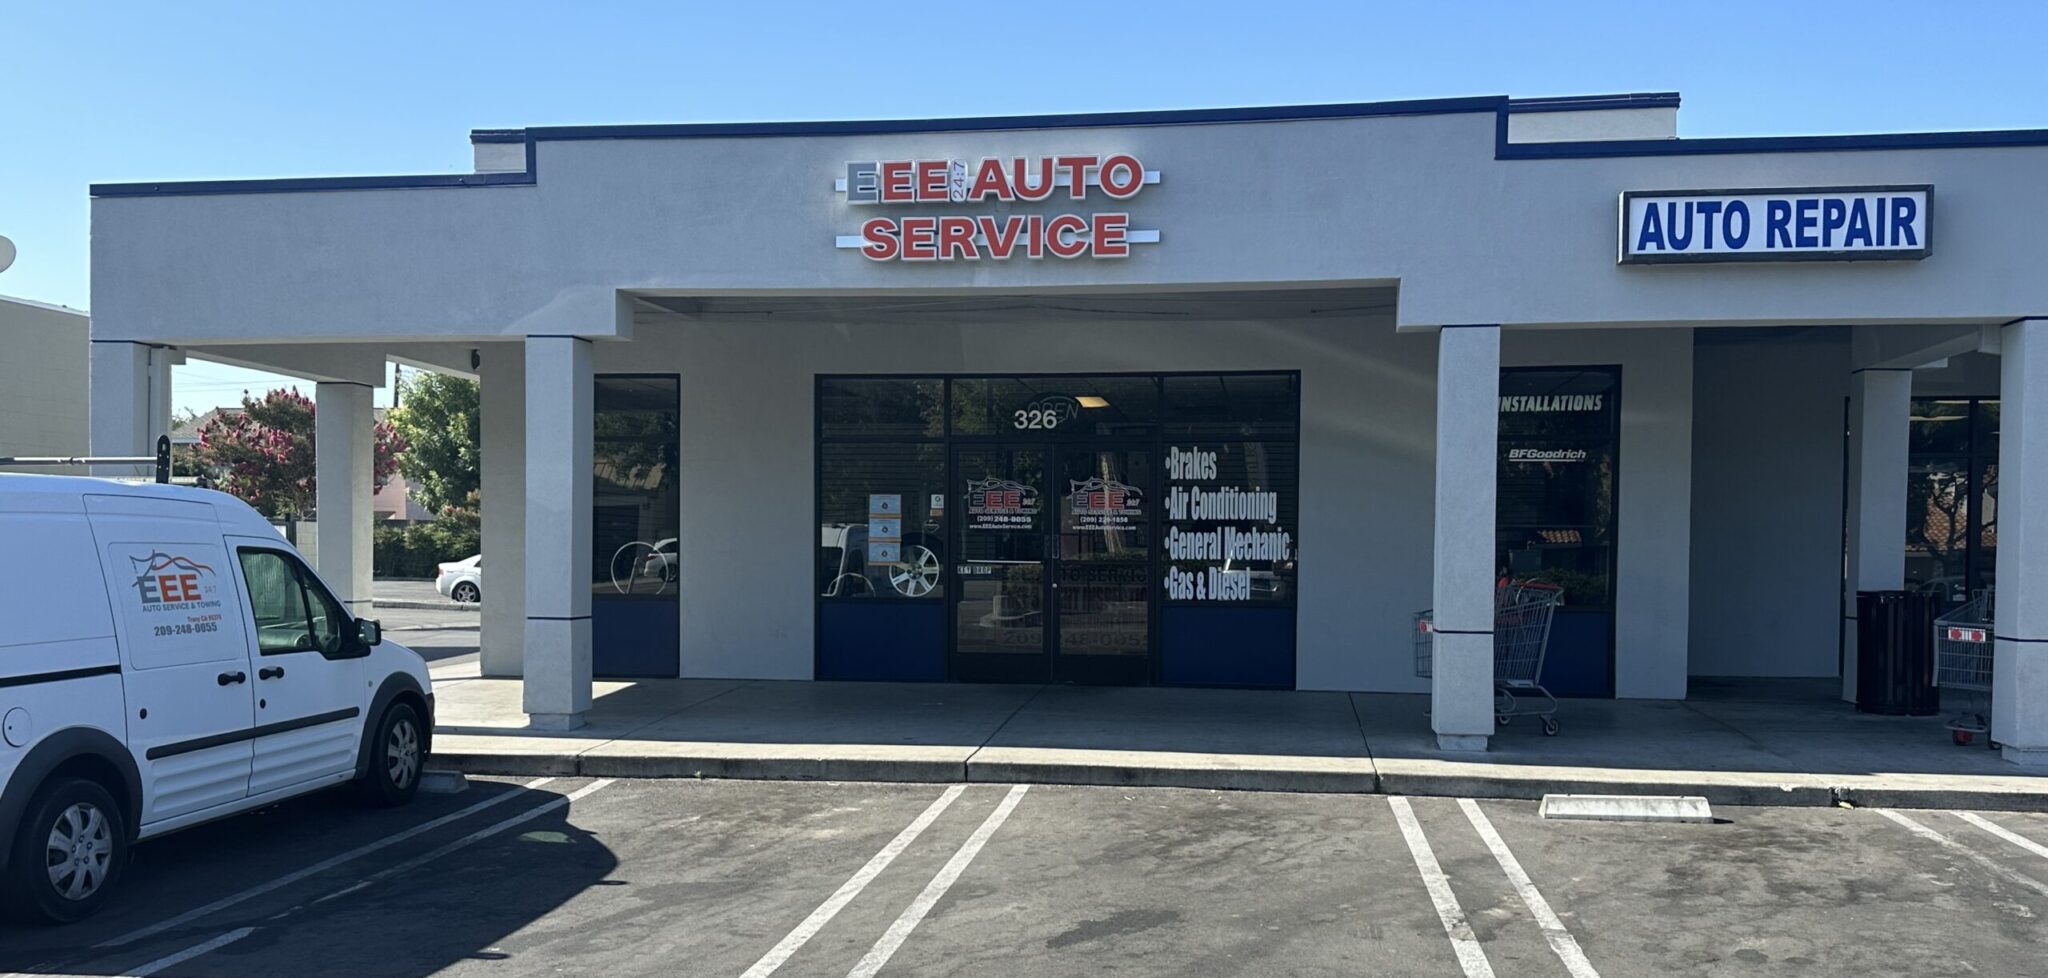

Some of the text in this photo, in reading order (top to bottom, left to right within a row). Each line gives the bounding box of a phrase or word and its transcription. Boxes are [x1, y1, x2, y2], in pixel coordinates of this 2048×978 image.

[967, 154, 1143, 201] AUTO
[861, 214, 1129, 261] SERVICE
[1637, 196, 1918, 251] AUTO REPAIR
[1014, 409, 1058, 430] 326
[1170, 446, 1217, 480] Brakes
[1508, 448, 1587, 459] BFGoodrich
[968, 490, 1021, 508] EEE
[1169, 485, 1277, 525] Air Conditioning
[1169, 526, 1290, 561] General Mechanic
[137, 574, 201, 603] EEE
[1169, 566, 1250, 600] Gas & Diesel
[143, 604, 161, 612] AUTO
[162, 602, 189, 611] SERVICE
[197, 600, 221, 608] TOWING
[154, 622, 217, 636] 209-248-0055
